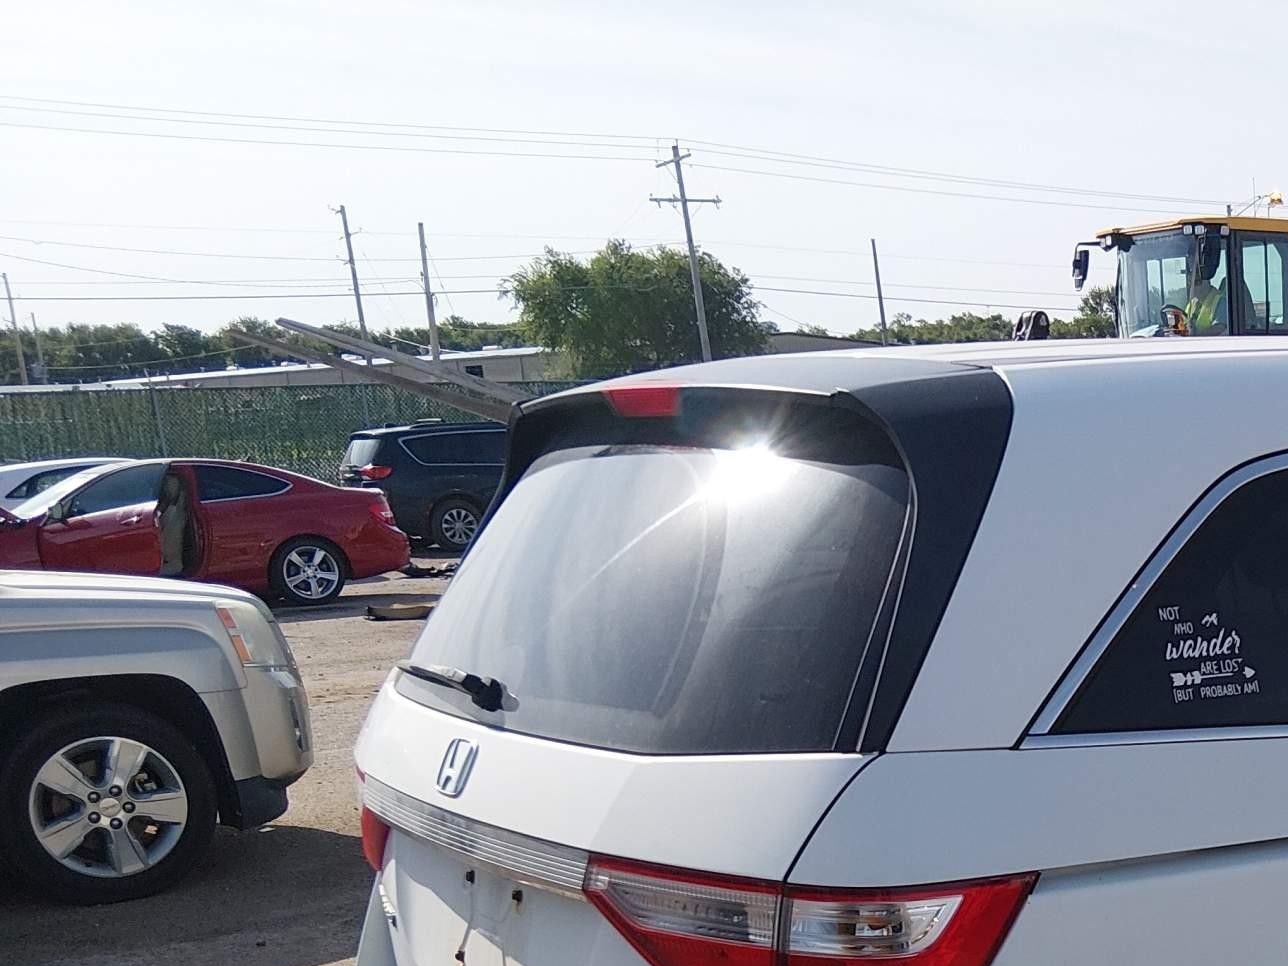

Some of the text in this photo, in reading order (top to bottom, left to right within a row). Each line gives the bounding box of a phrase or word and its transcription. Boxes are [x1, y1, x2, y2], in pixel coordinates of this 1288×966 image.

[1158, 606, 1180, 621] NOT
[1165, 627, 1241, 660] wander
[1200, 660, 1219, 674] ARE
[1200, 683, 1242, 698] PROBABLY
